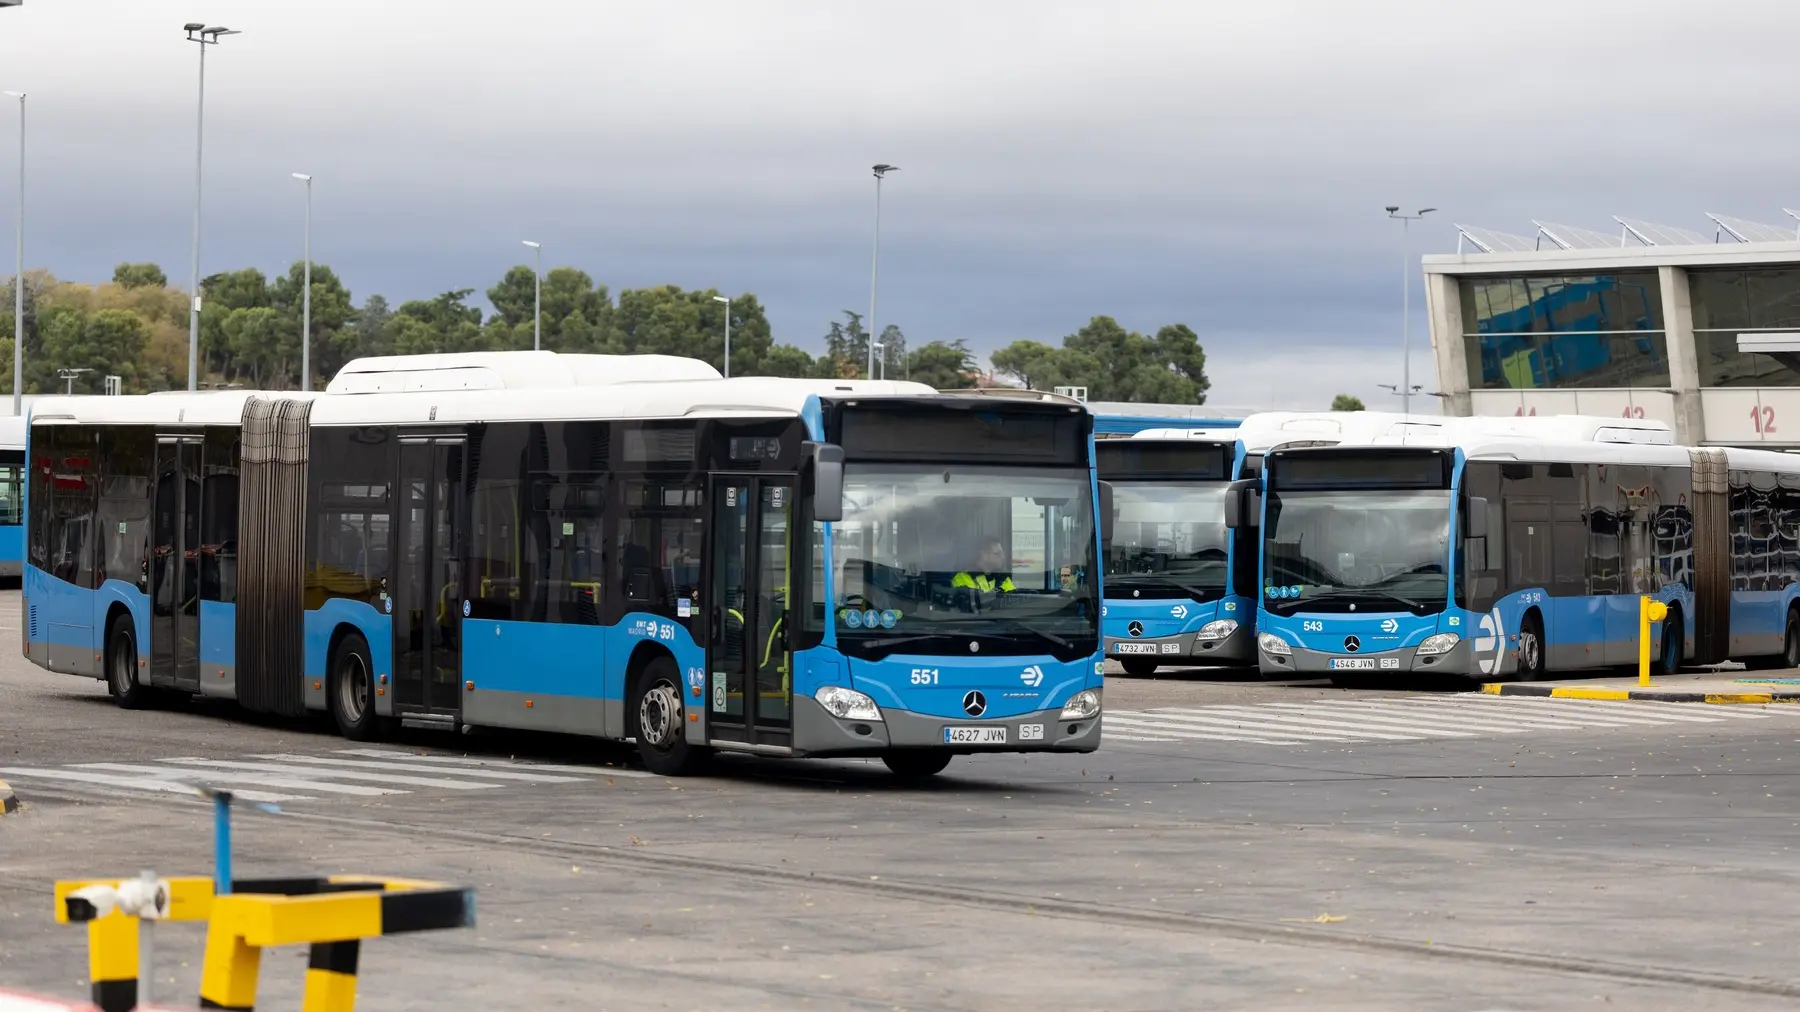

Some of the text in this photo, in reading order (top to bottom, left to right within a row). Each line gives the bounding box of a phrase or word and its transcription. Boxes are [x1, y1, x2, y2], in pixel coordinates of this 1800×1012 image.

[1750, 405, 1777, 433] 12
[636, 620, 675, 640] EMT 551
[1303, 620, 1323, 632] 543
[1119, 643, 1155, 653] 4732 JVN
[1163, 644, 1178, 653] SP
[1335, 659, 1373, 669] 4546 JVN
[1382, 659, 1398, 668] SP
[910, 668, 939, 685] 551
[951, 729, 1005, 742] 4627 JVN
[1021, 725, 1041, 738] SP
